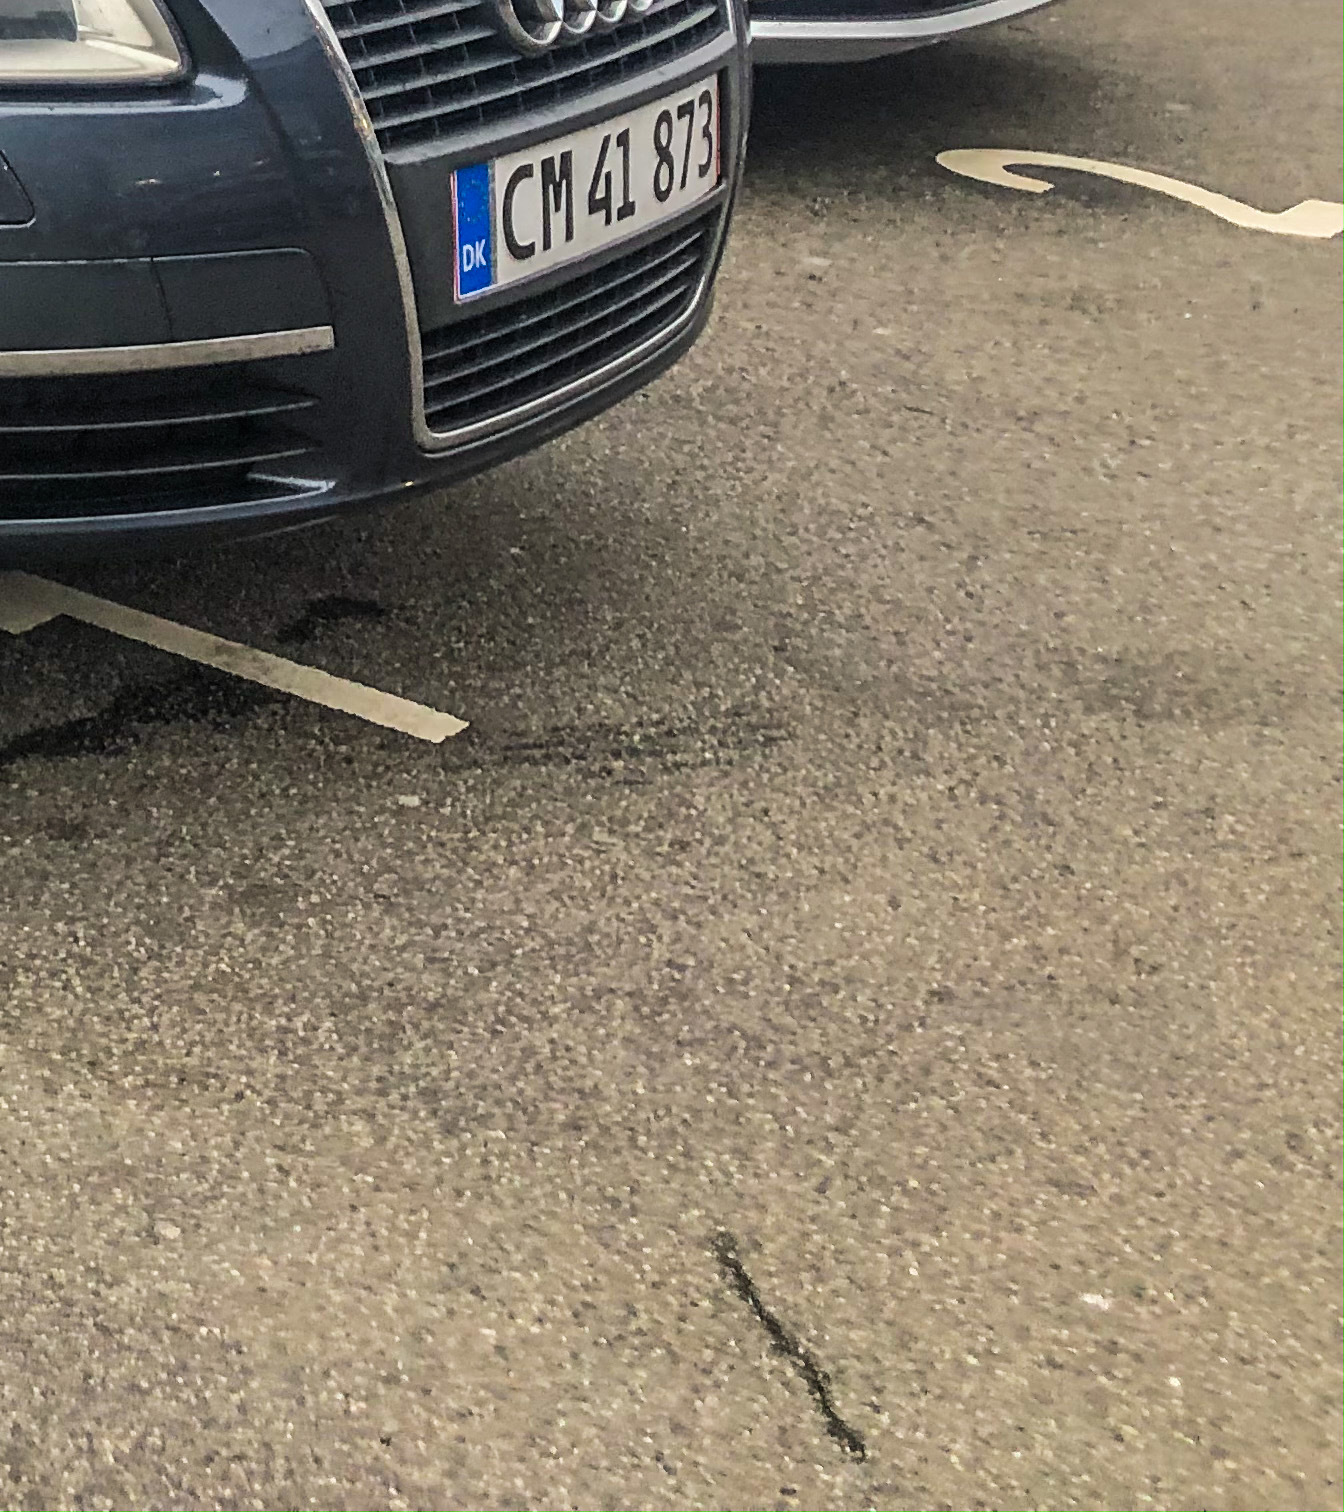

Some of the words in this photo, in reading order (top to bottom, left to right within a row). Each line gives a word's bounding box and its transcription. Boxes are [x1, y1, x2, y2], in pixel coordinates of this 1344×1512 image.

[502, 150, 574, 262] CM
[587, 127, 637, 226] 41
[653, 89, 713, 204] 873
[462, 237, 487, 273] DK
